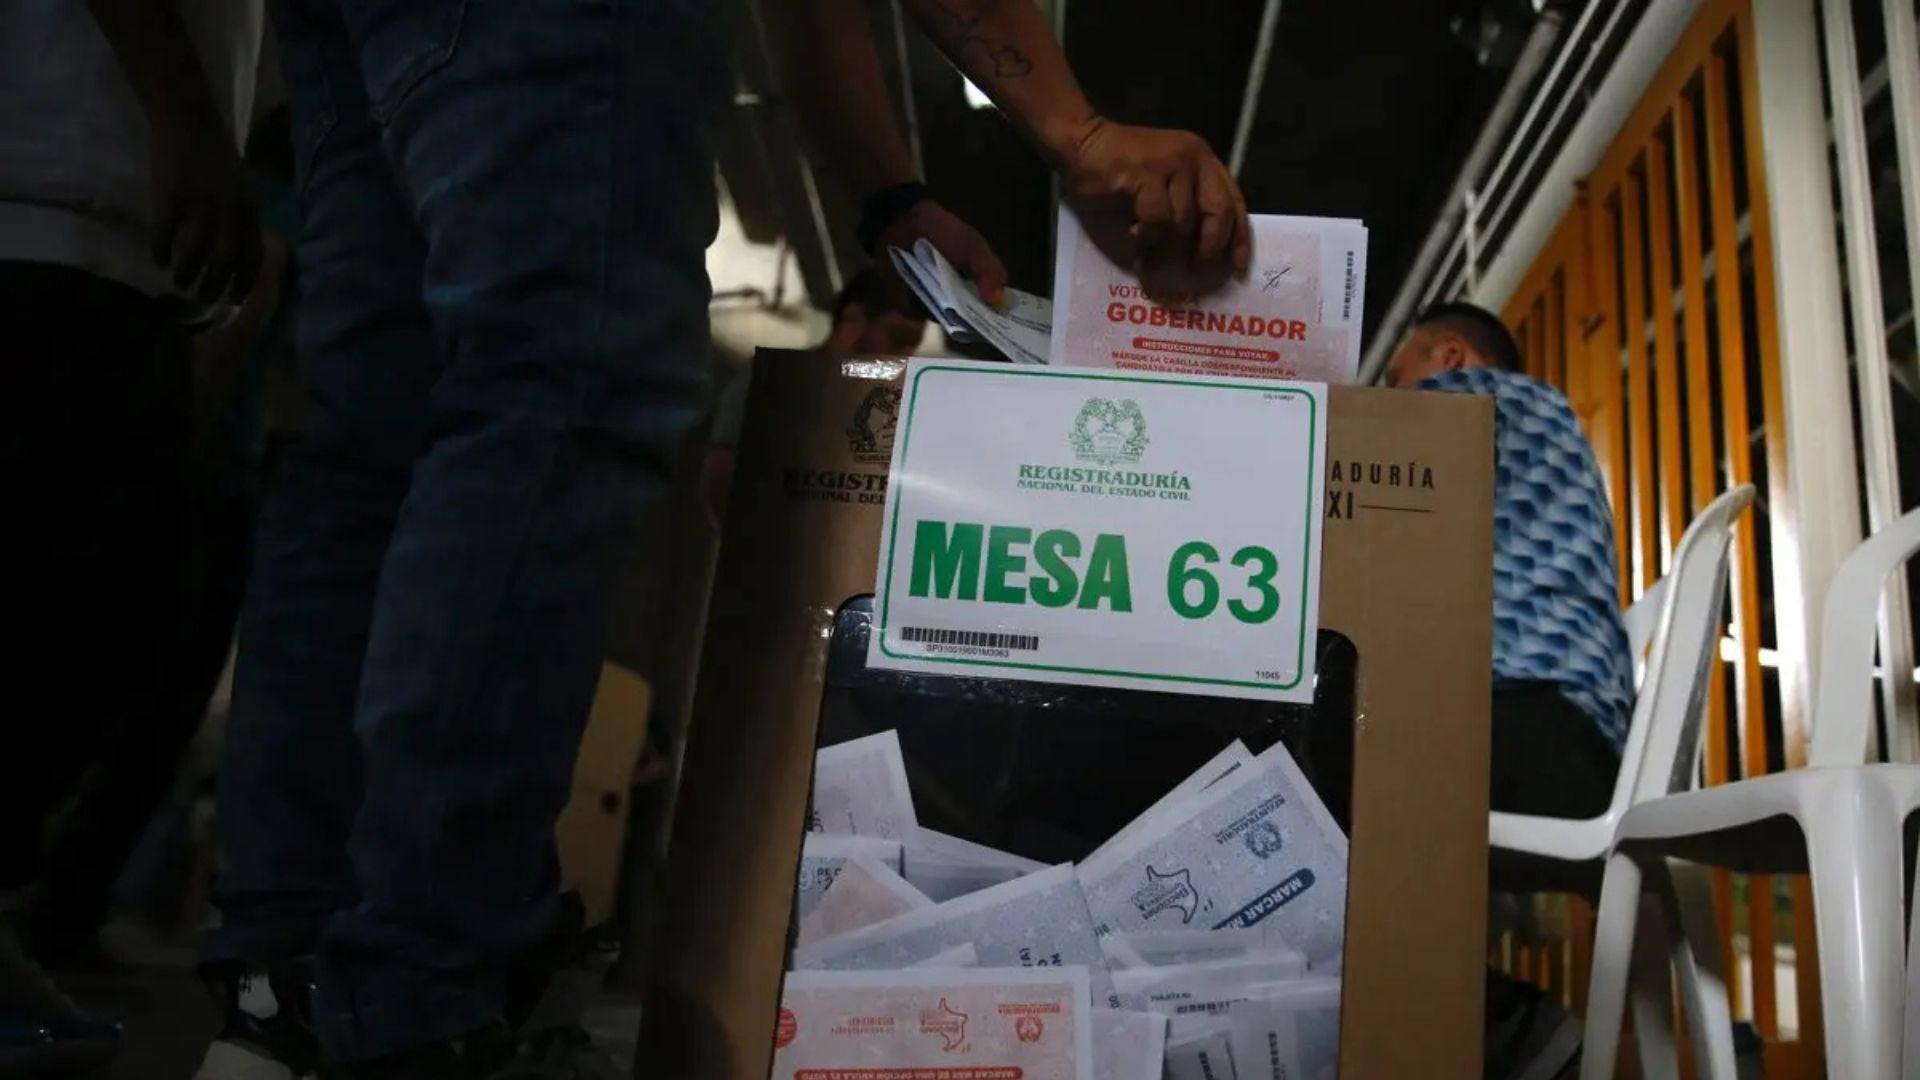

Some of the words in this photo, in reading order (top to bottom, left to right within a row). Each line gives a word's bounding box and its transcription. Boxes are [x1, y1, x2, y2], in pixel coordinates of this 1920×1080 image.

[1106, 302, 1307, 341] GOBERNADOR
[1142, 341, 1211, 355] INSTRUCCIONES
[1017, 478, 1076, 493] NACIONAL
[1080, 482, 1106, 495] DEL
[1109, 484, 1156, 498] ESTADO
[1159, 487, 1192, 501] CIVIL
[1019, 464, 1191, 489] REGISTRADURÍA
[1330, 461, 1435, 490] ADURÍA
[909, 519, 1133, 613] MESA
[1166, 541, 1281, 625] 63
[1248, 875, 1304, 922] MARCAR
